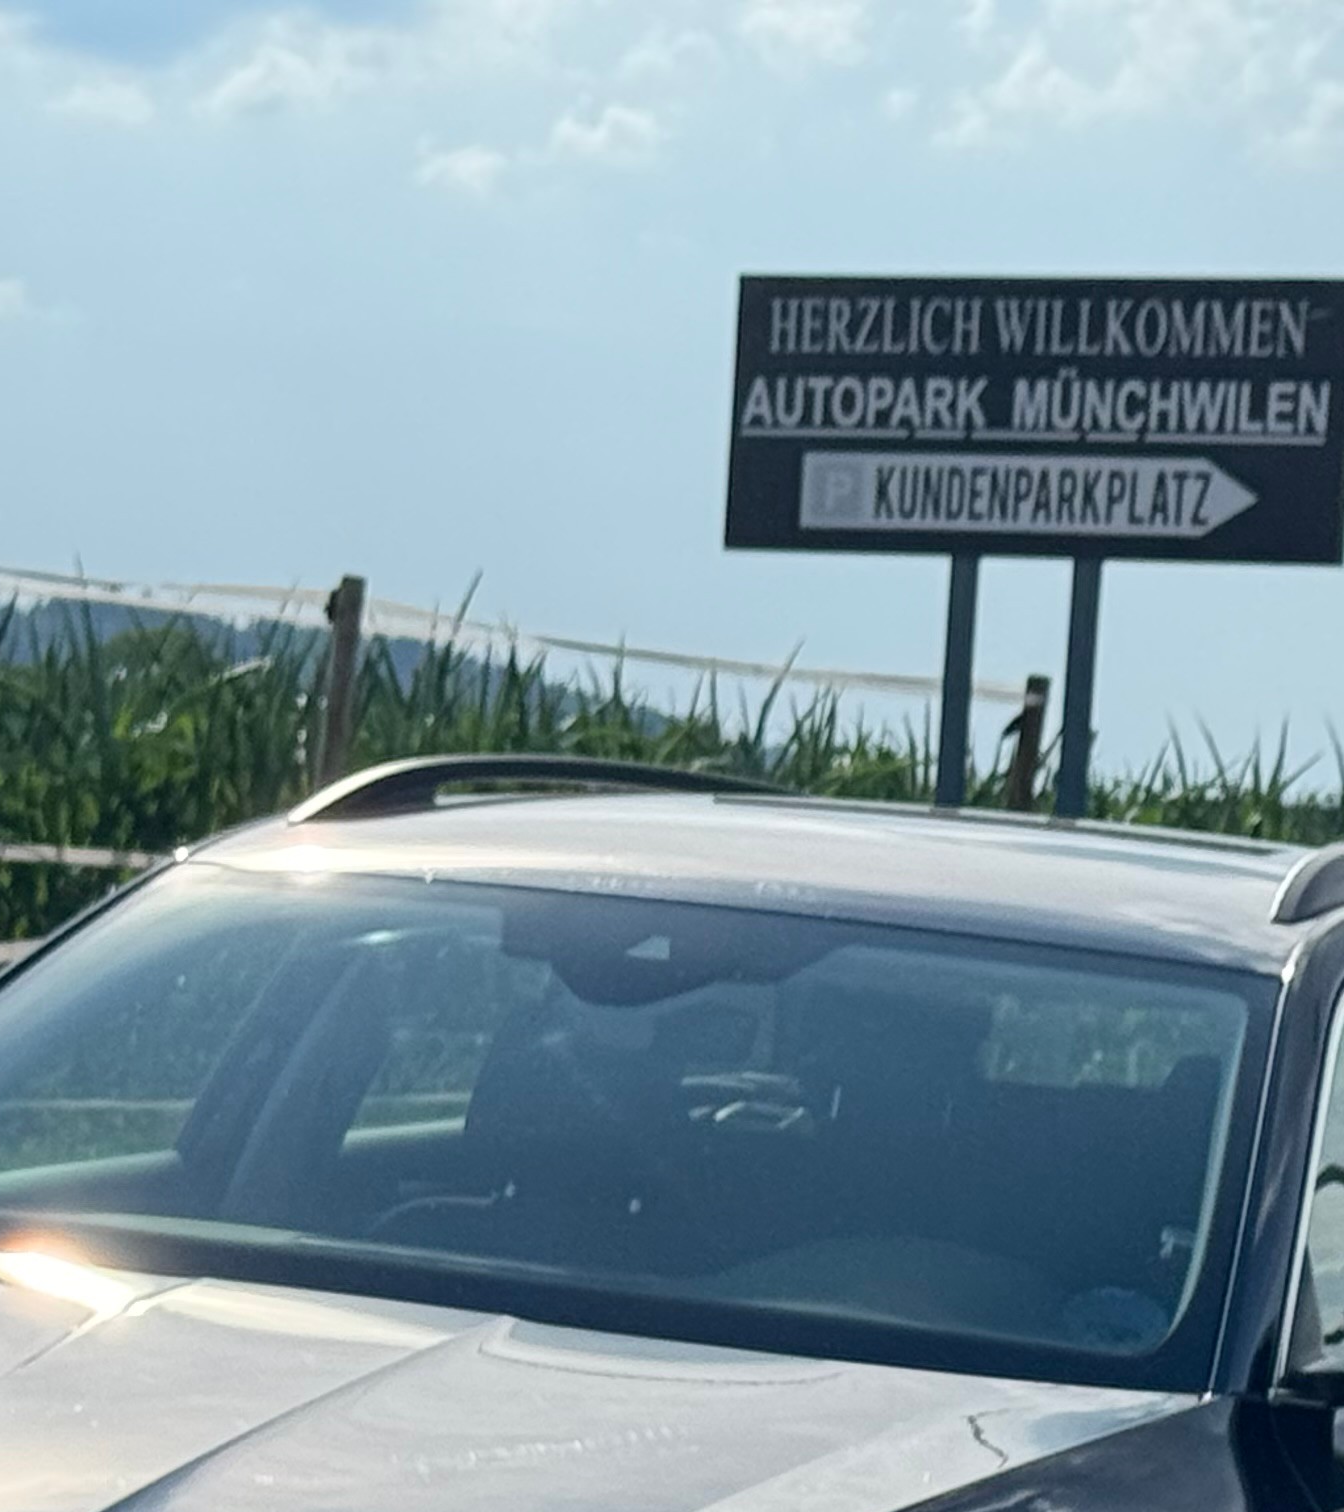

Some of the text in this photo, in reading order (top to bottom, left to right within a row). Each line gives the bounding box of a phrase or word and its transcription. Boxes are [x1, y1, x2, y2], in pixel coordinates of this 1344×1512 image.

[769, 297, 1310, 358] HERZLICH WILLKOMMEN
[742, 366, 1332, 435] AUTOPARK MÜNCHWILEN
[873, 465, 1213, 527] KUNDENPARKPLATZ
